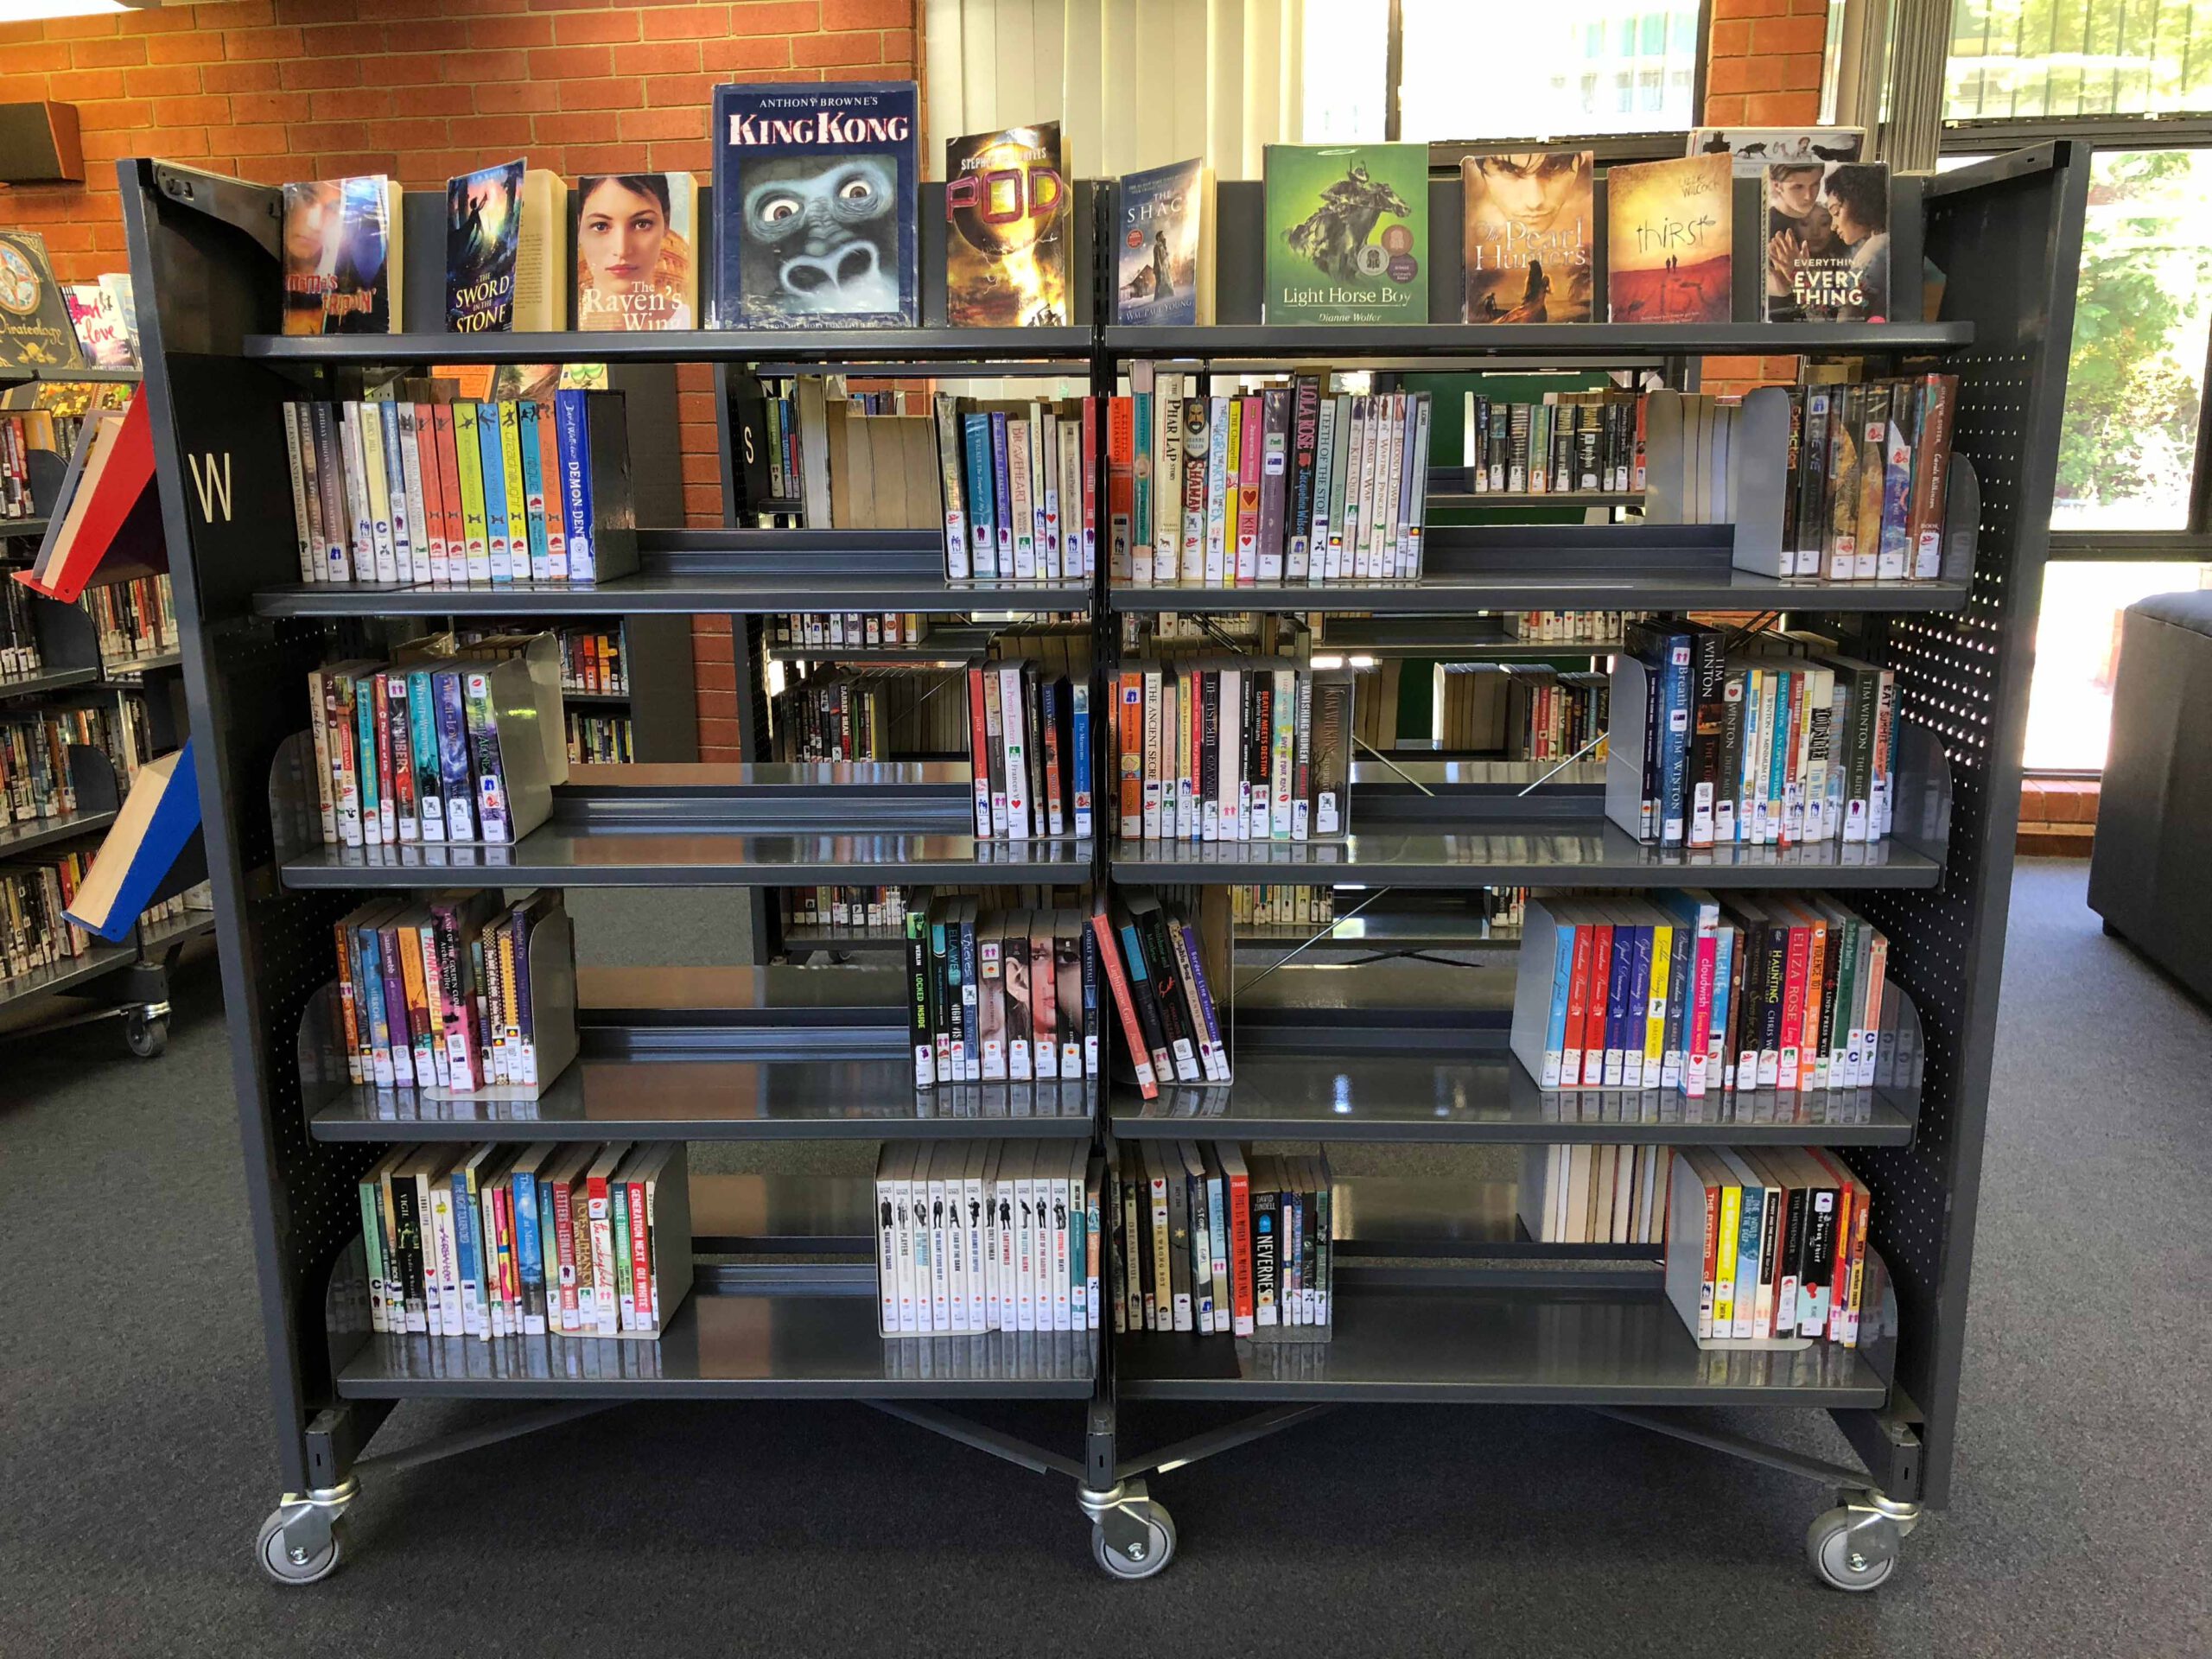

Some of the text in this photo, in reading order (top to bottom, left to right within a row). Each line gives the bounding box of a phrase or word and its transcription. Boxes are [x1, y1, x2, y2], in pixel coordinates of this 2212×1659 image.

[760, 96, 878, 108] ANTHONY BROWNE'S
[728, 111, 907, 145] KING KONG
[946, 167, 1062, 224] POD
[1154, 191, 1171, 201] THE
[1505, 217, 1584, 250] Pearl
[1475, 246, 1586, 270] Hunters
[456, 275, 509, 308] SWORD
[480, 272, 491, 282] THE
[632, 282, 655, 293] The
[1794, 271, 1863, 288] EVERY
[481, 299, 492, 308] THE
[585, 289, 682, 312] Raven's
[1164, 301, 1192, 311] YOUNG
[1284, 287, 1411, 306] Light Horse Boy
[1792, 289, 1863, 305] THING
[83, 319, 117, 344] love
[456, 304, 505, 334] STONE
[1319, 313, 1350, 322] Dianne
[1167, 399, 1180, 433] PHAR
[745, 427, 753, 463] S
[1167, 438, 1180, 461] LAP
[1294, 385, 1316, 536] LOLA ROSE Jacqueline Wilson
[1319, 413, 1332, 485] TEETH OF THE
[1392, 438, 1402, 472] BLOODY
[1013, 428, 1025, 504] BRAVEHEART
[1376, 438, 1389, 518] WARTIME PRINCESS
[188, 453, 232, 523] W
[1187, 460, 1205, 512] SHAMAN
[1714, 658, 1724, 681] TIM
[1007, 691, 1015, 713] Peony
[1300, 685, 1310, 729] VANISHING
[1702, 642, 1714, 764] WINTON THE
[1778, 694, 1787, 728] WINTON
[1148, 706, 1157, 747] ANCIENT
[1671, 667, 1688, 810] Breath TIM WINTON
[1724, 702, 1738, 774] WINTON DIRT
[1777, 734, 1783, 745] AN
[1856, 680, 1872, 771] TIM WINTON THE
[1879, 710, 1890, 744] SUMMER
[949, 930, 957, 950] ELLA
[961, 931, 973, 977] Thieves
[424, 937, 436, 982] FRANKIE
[1191, 951, 1207, 997] Border Line
[1713, 941, 1727, 995] Wildlife
[1770, 950, 1783, 1003] HAUNTING
[1811, 944, 1822, 990] VIOLENCE 101
[1110, 963, 1132, 1024] Lighthouse Girl
[1788, 933, 1803, 1021] ELIZA ROSE
[370, 988, 379, 1019] MIRROR
[1694, 959, 1710, 1053] cloudwish fiona wood
[1766, 1010, 1776, 1036] CHRIS
[400, 1194, 410, 1218] VIGIL
[1214, 1192, 1224, 1243] ELSEWHERE
[1743, 1216, 1751, 1228] THE
[1751, 1199, 1760, 1238] ONE WOULD
[615, 1191, 628, 1259] TROUBLE TOMORROW
[1789, 1212, 1798, 1253] MESSENGER
[556, 1190, 574, 1309] LETTERS WHITE
[632, 1189, 648, 1307] GENERATION NEXT OLI WHITE
